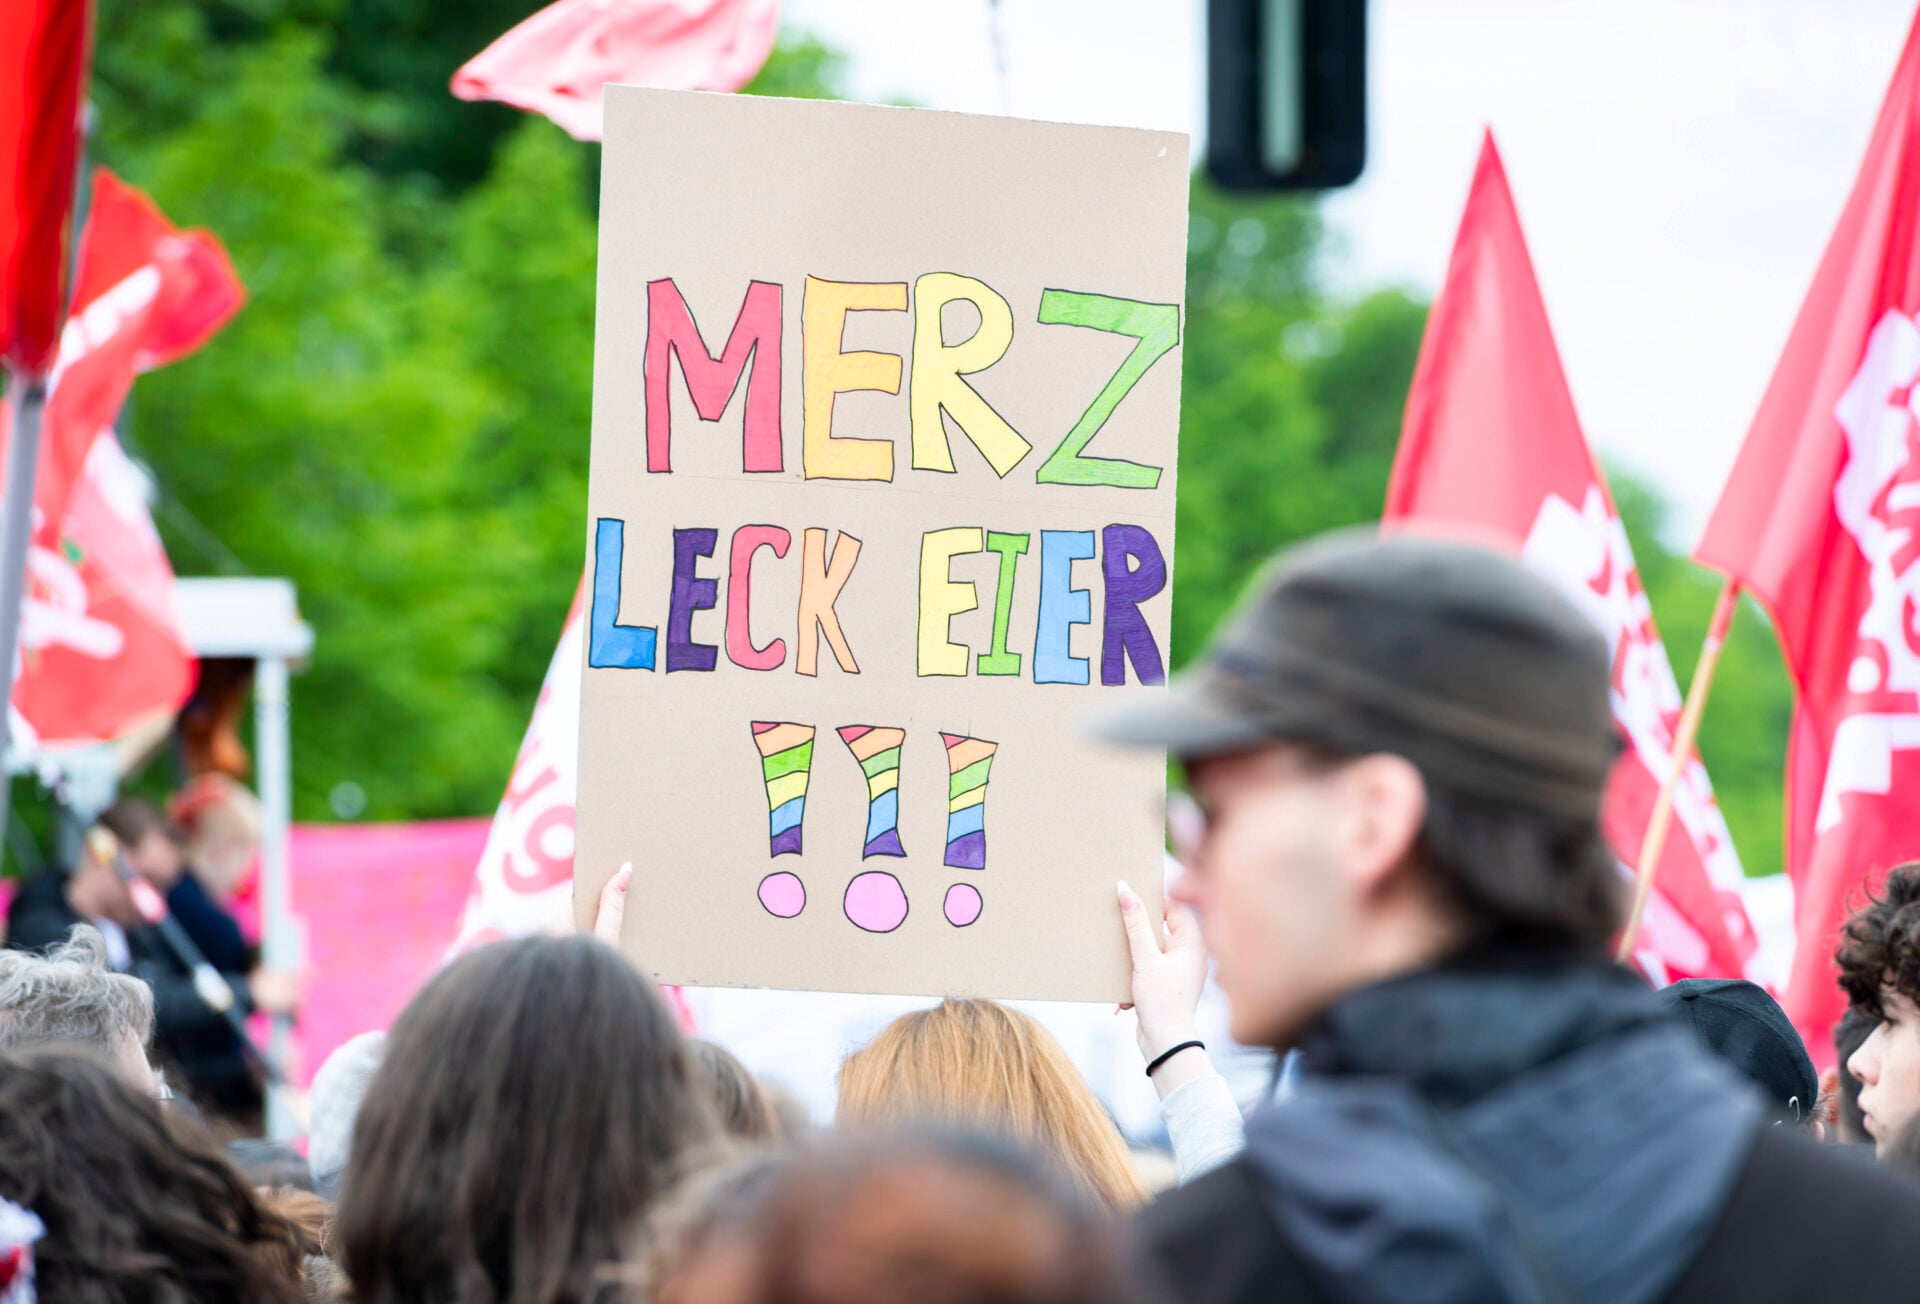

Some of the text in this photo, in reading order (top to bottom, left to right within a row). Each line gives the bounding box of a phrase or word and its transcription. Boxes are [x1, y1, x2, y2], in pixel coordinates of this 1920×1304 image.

[644, 271, 1181, 489] MERZ
[588, 518, 1167, 686] LECK EIER
[750, 720, 999, 933] !!!
